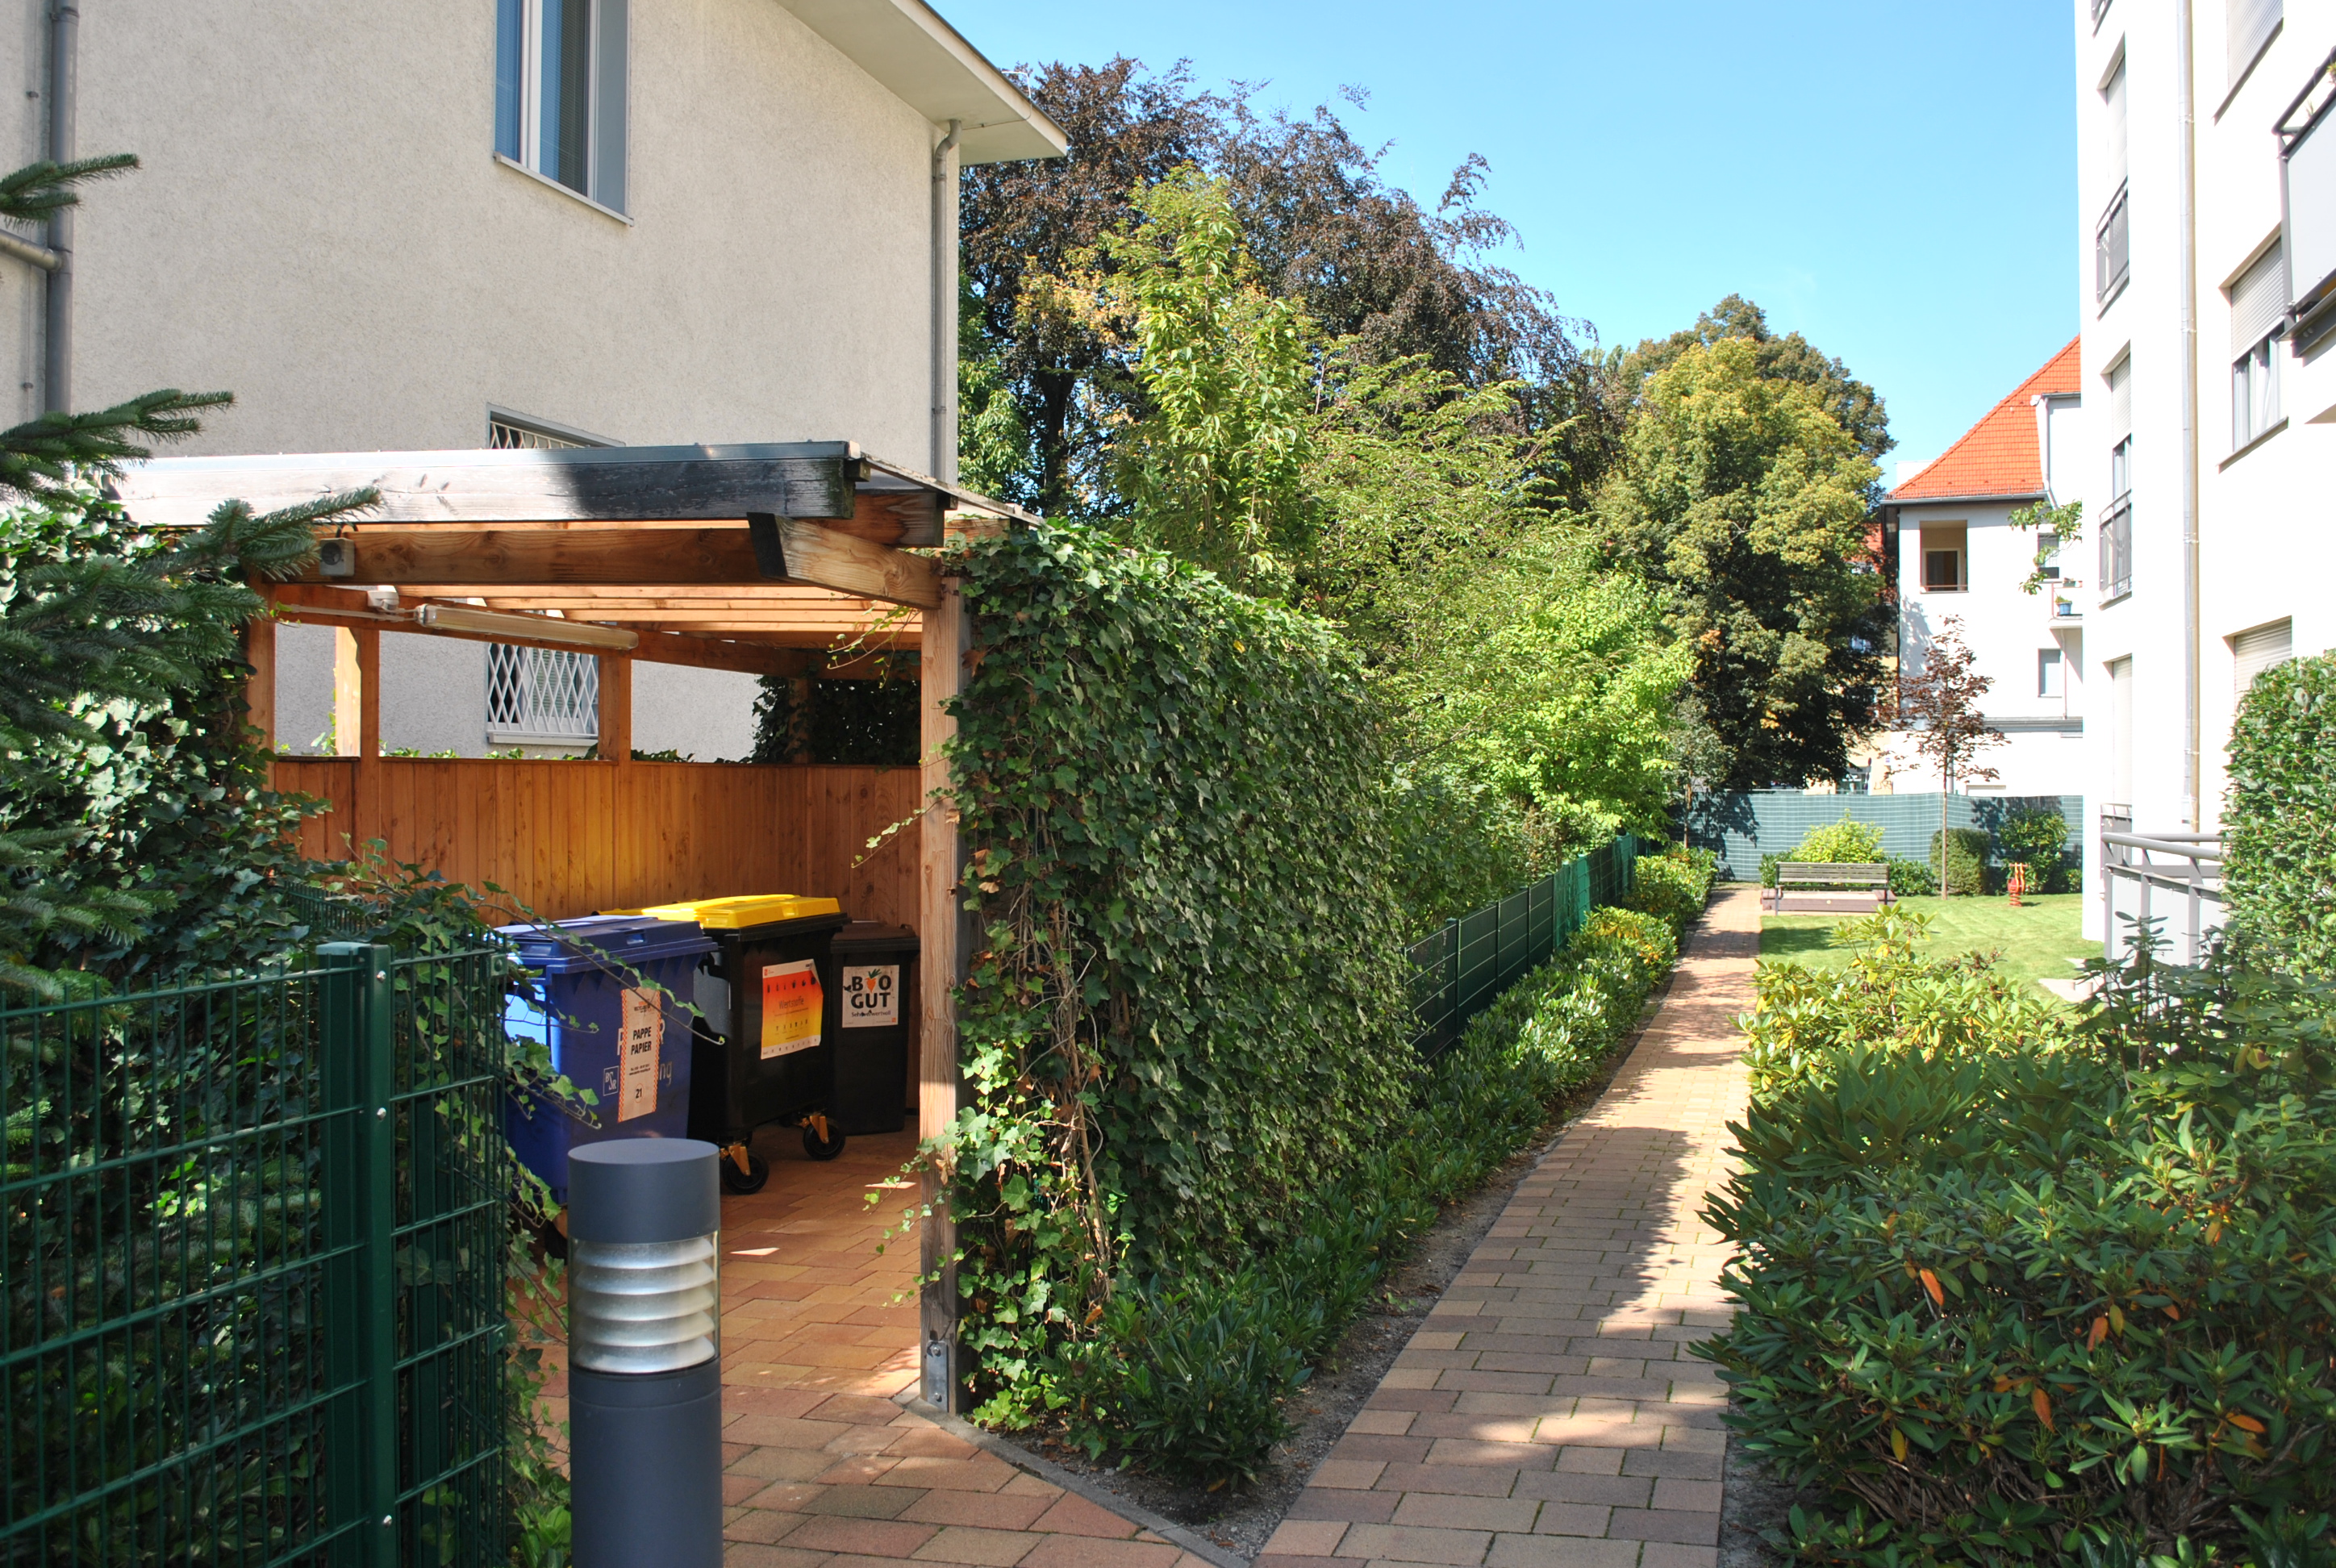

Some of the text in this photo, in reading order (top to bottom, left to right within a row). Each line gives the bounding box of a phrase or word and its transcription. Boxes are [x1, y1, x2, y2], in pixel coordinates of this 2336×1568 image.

[850, 993, 891, 1009] GUT
[632, 1027, 652, 1040] PAPPE
[630, 1040, 652, 1056] PAPIER
[635, 1088, 642, 1099] 21
